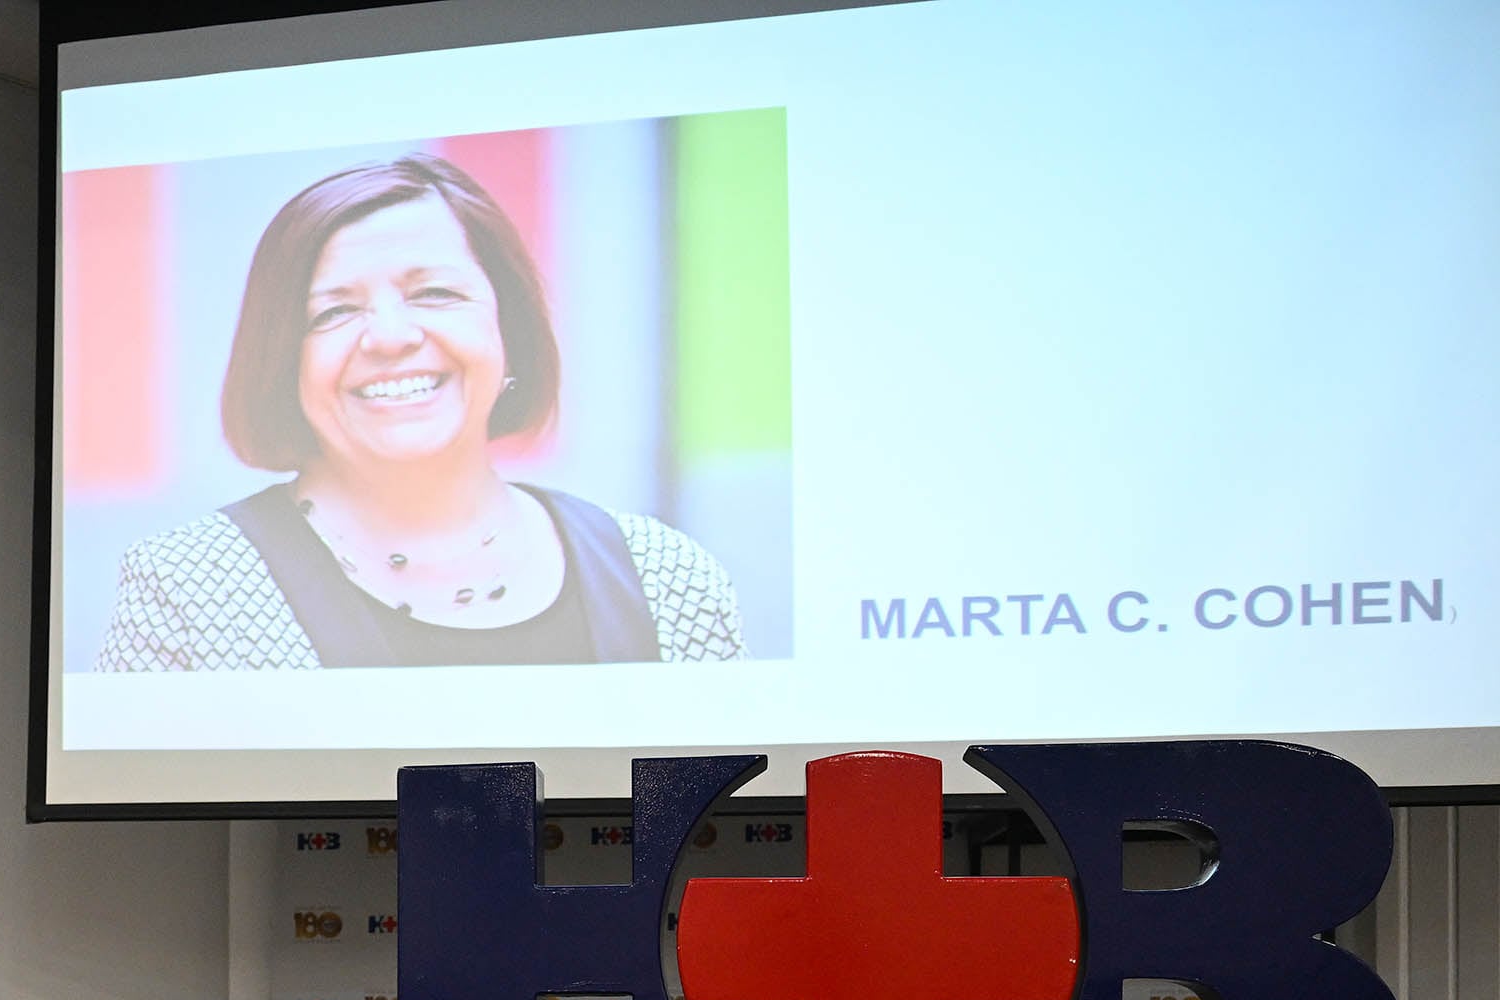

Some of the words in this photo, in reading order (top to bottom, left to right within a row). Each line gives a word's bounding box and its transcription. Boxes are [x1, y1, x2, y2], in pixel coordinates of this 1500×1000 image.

[859, 592, 1088, 640] MARTA
[1107, 590, 1169, 633] C.
[366, 827, 397, 855] 18
[293, 911, 343, 939] 180
